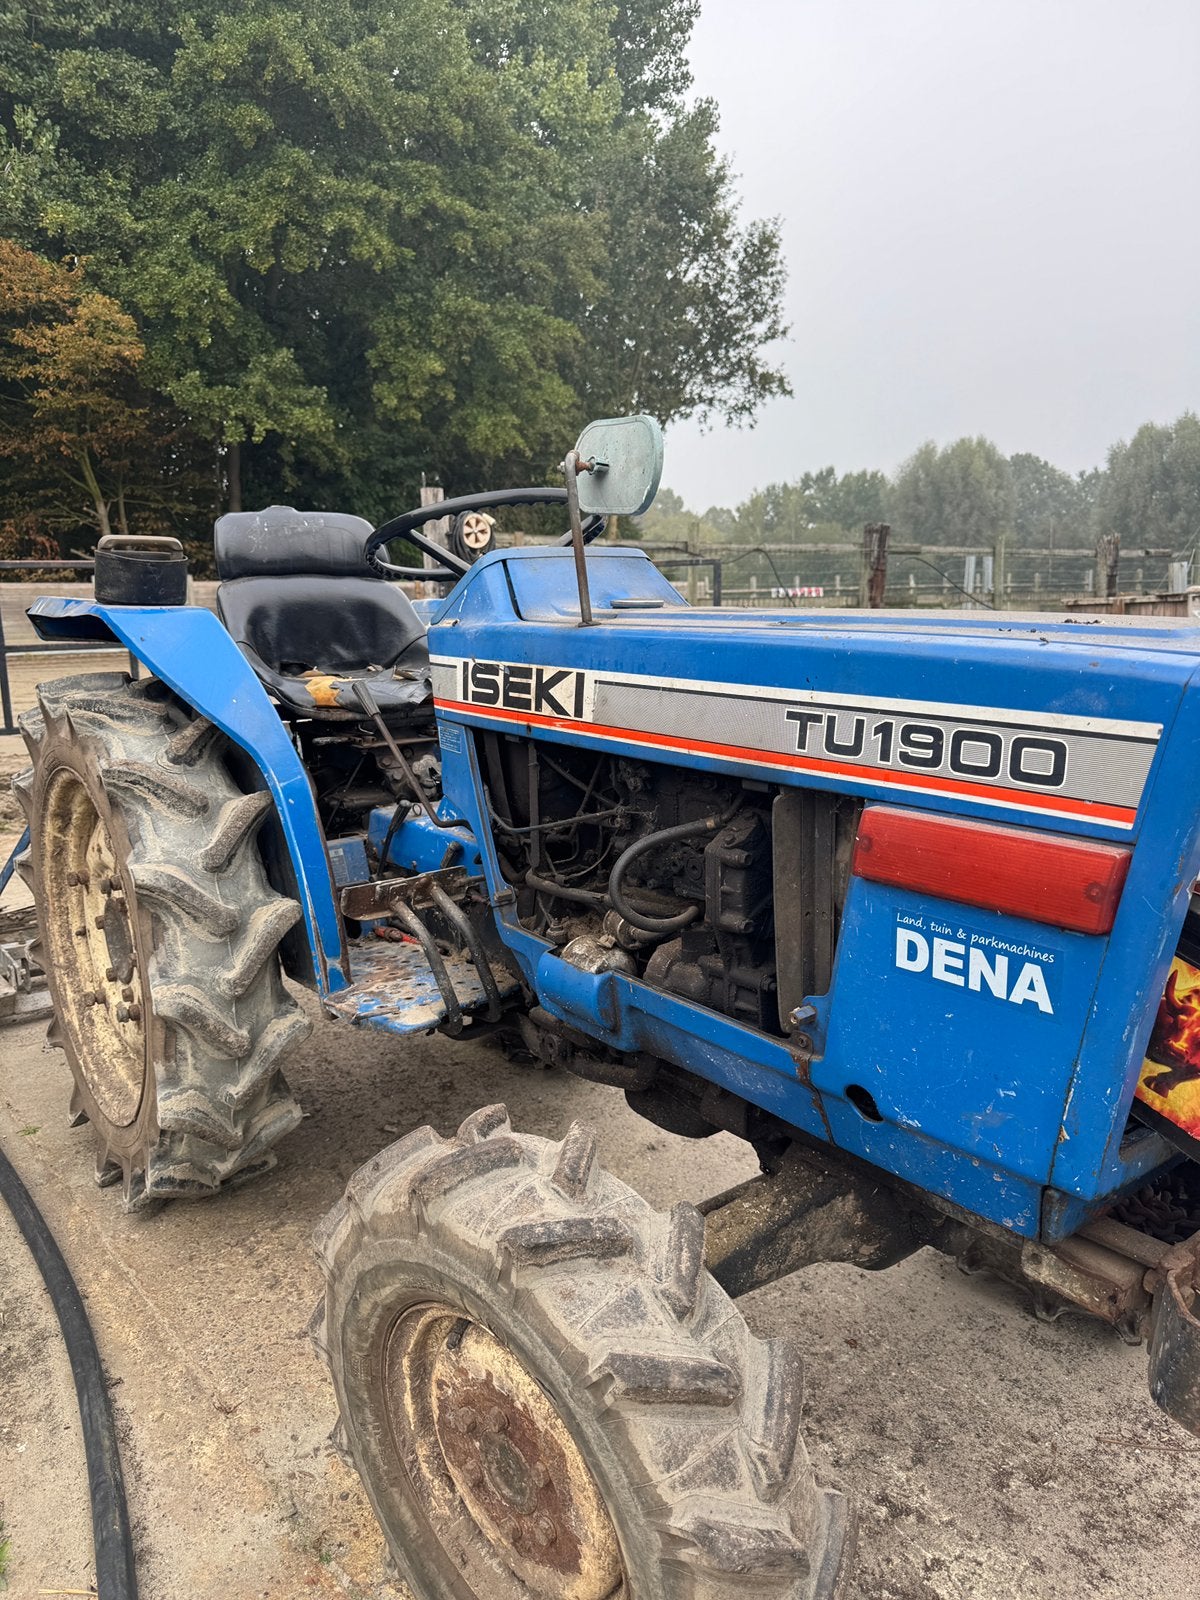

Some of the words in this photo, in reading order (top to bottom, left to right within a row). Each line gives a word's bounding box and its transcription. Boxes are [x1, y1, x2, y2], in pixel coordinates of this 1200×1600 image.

[462, 661, 585, 718] ISEKI
[785, 709, 1068, 788] TU1900
[896, 912, 927, 930] Land,
[930, 920, 953, 936] tuin
[956, 927, 967, 940] &
[970, 932, 1055, 964] parkmachines
[896, 927, 1054, 1015] DENA
